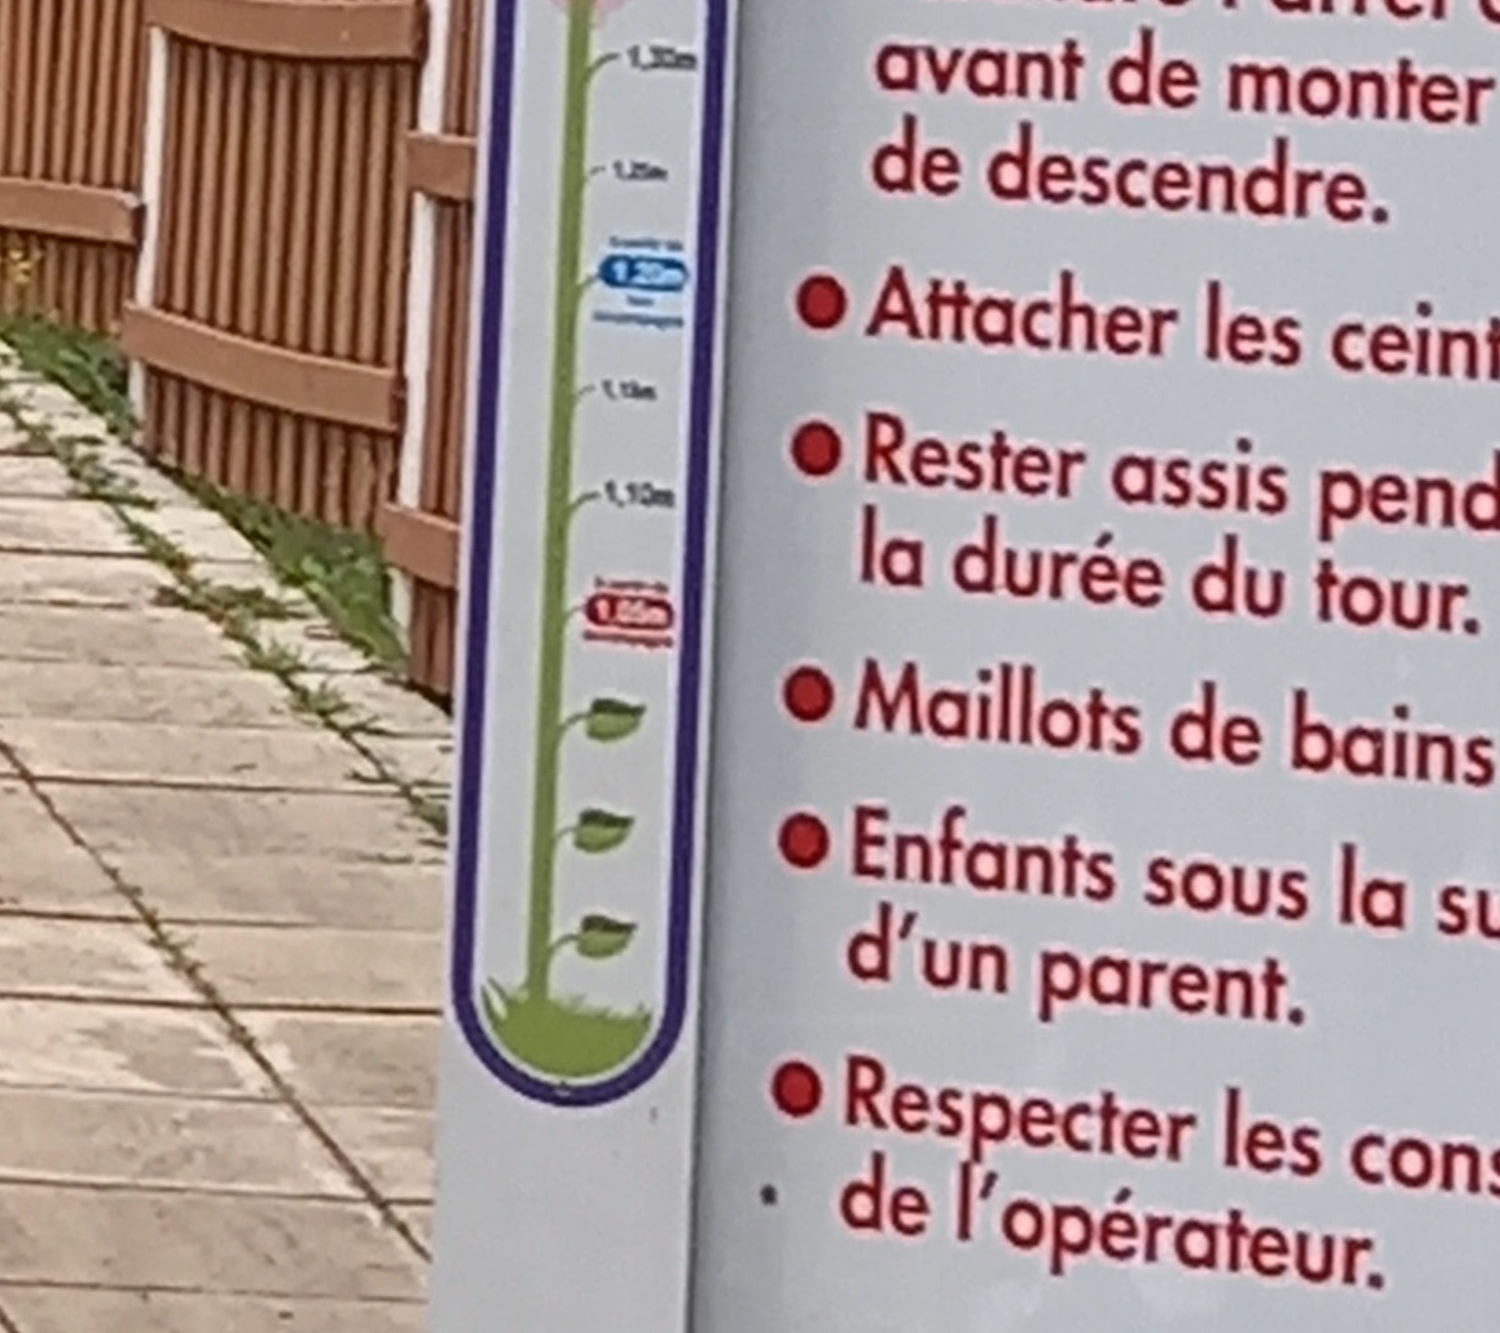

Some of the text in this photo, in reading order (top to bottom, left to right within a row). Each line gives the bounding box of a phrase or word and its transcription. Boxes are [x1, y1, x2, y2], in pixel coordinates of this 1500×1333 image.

[876, 28, 1495, 124] avant de monter
[872, 114, 1388, 223] de descendre.
[866, 266, 1178, 355] Attacher
[1206, 281, 1301, 366] les
[865, 412, 1500, 542] Rester assis pend
[862, 504, 1478, 634] la durée du tour.
[855, 659, 1494, 787] Maillots de bains
[853, 806, 1115, 901] Enfants
[1145, 858, 1307, 920] sous
[1341, 844, 1405, 929] la
[848, 902, 1303, 1025] d'un parent.
[846, 1055, 1196, 1168] Respecter
[1225, 1088, 1321, 1176] les
[841, 1151, 1383, 1289] de l'opérateur.
